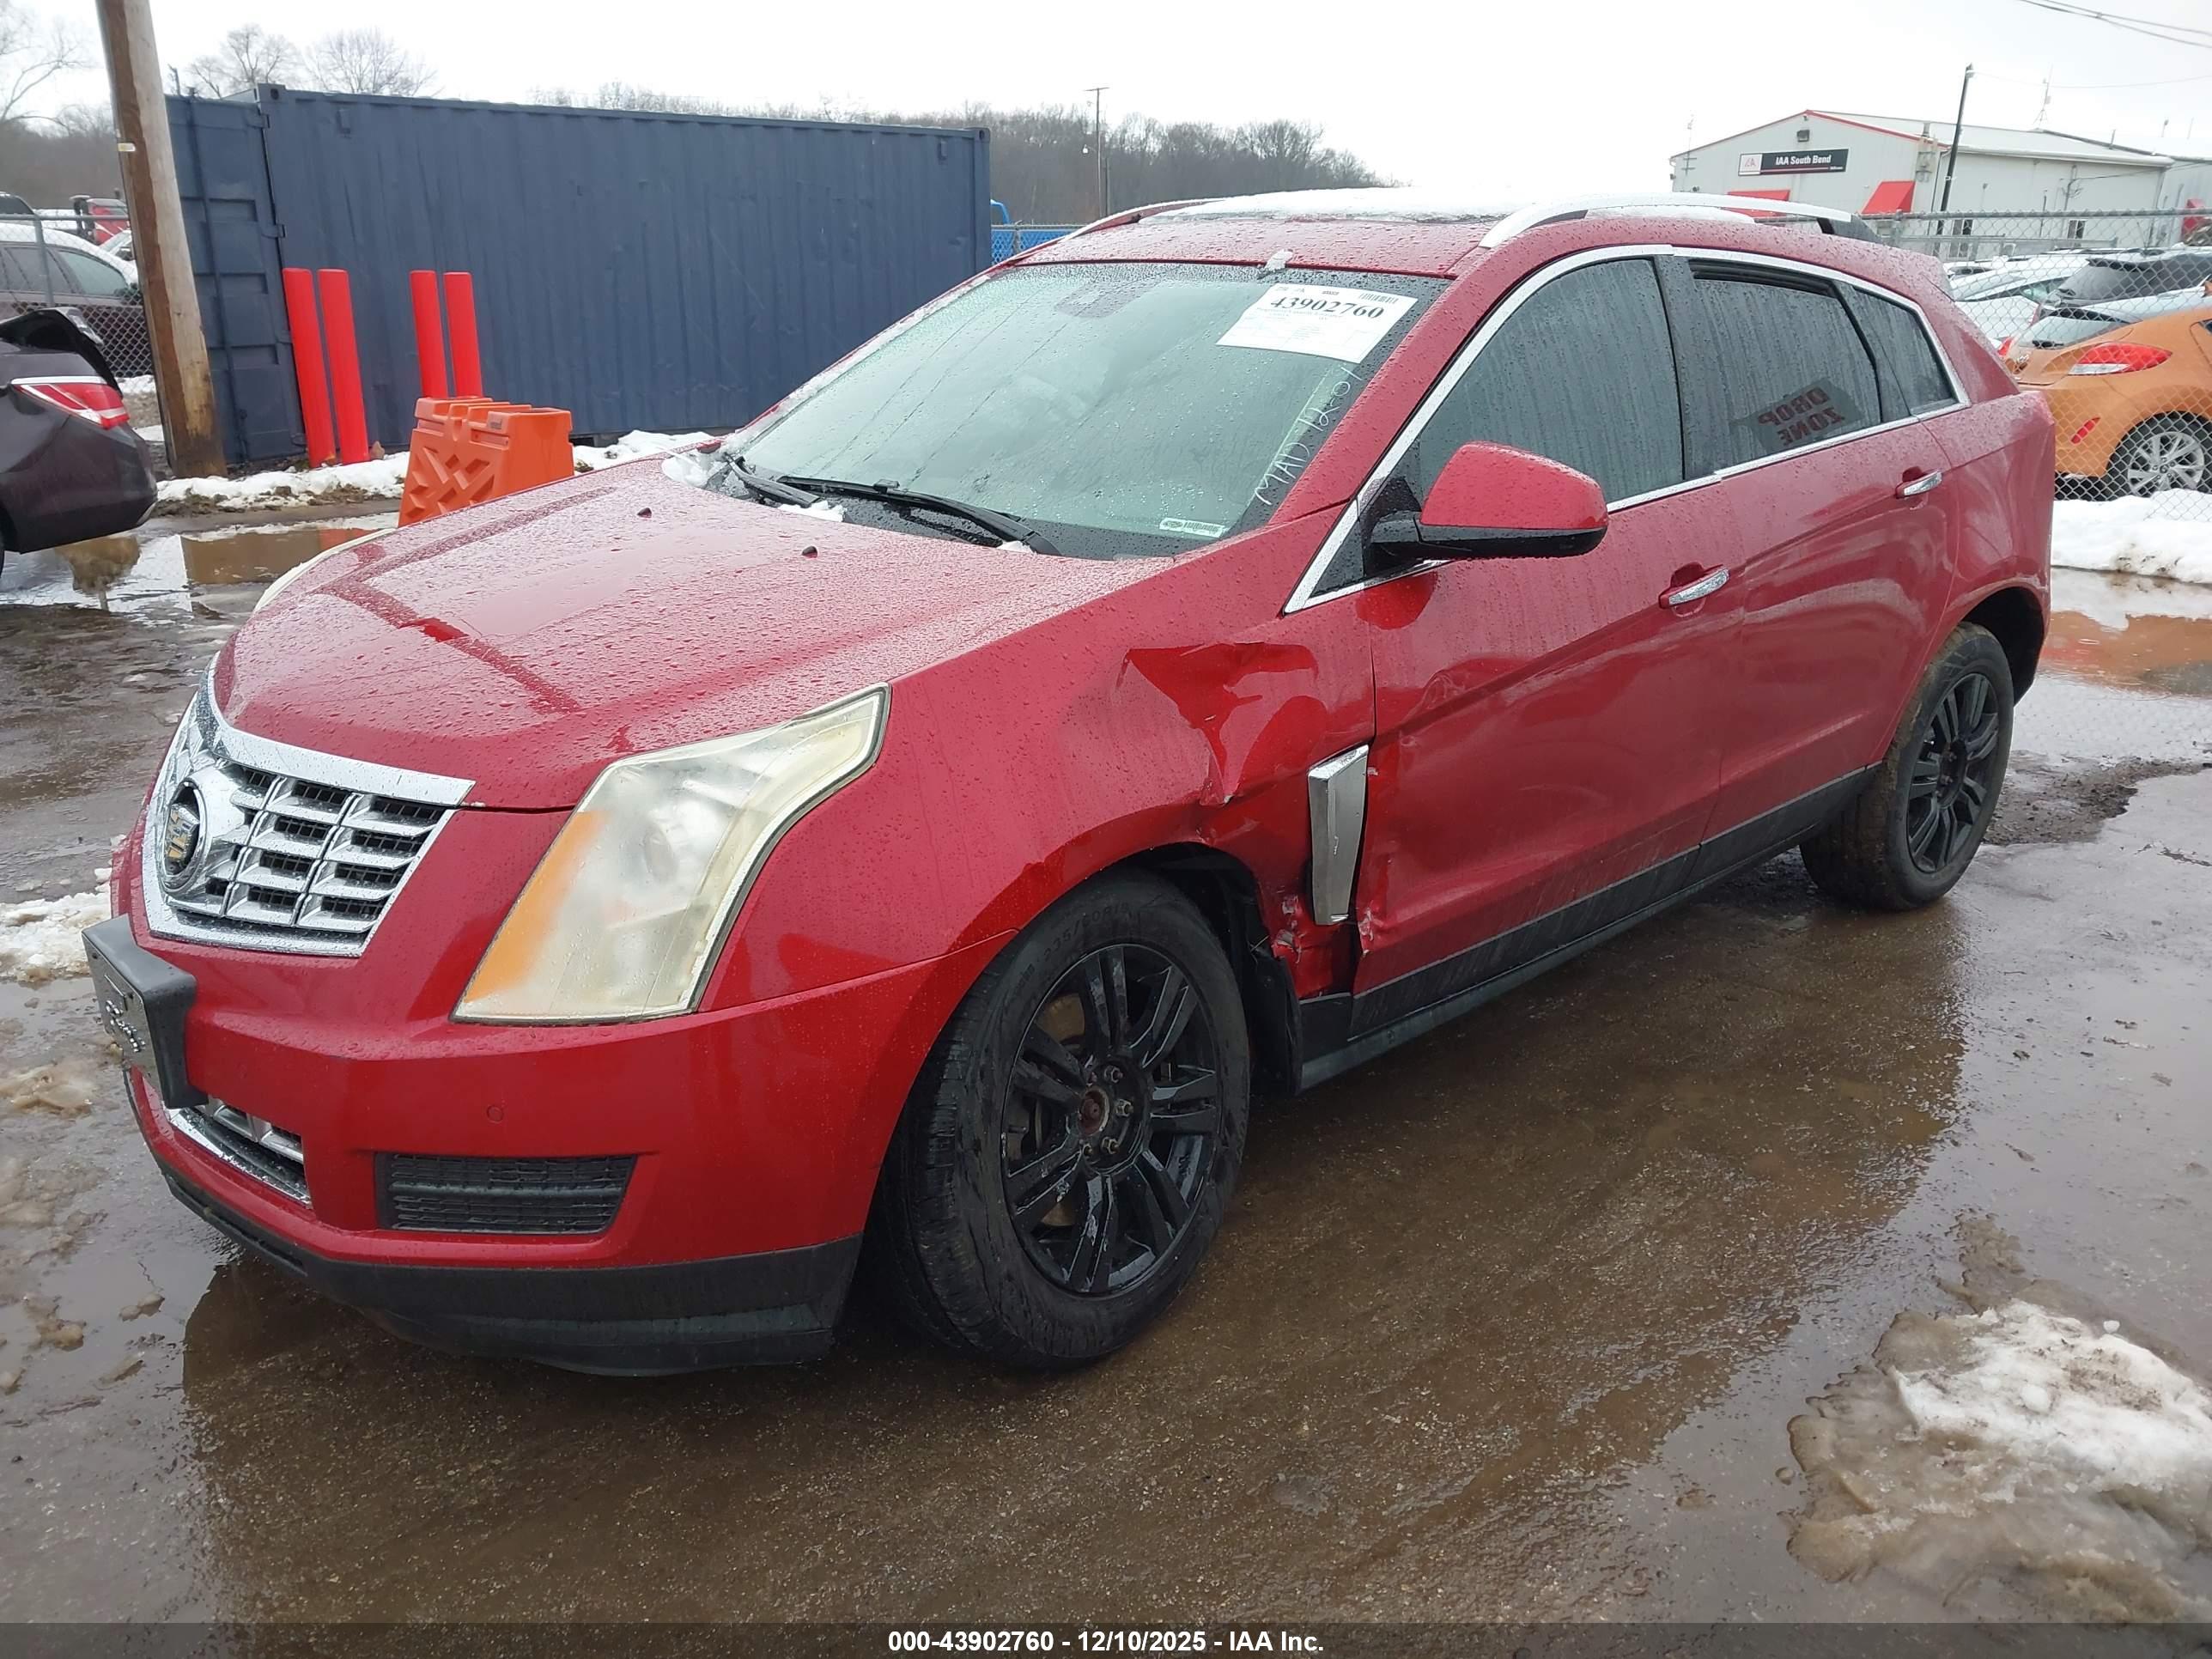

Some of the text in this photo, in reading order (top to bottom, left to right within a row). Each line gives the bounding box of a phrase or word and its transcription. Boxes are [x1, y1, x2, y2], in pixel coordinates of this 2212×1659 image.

[1775, 155, 1832, 166] IAA South Bend
[1270, 296, 1385, 319] 43902760
[1254, 441, 1311, 506] MAD
